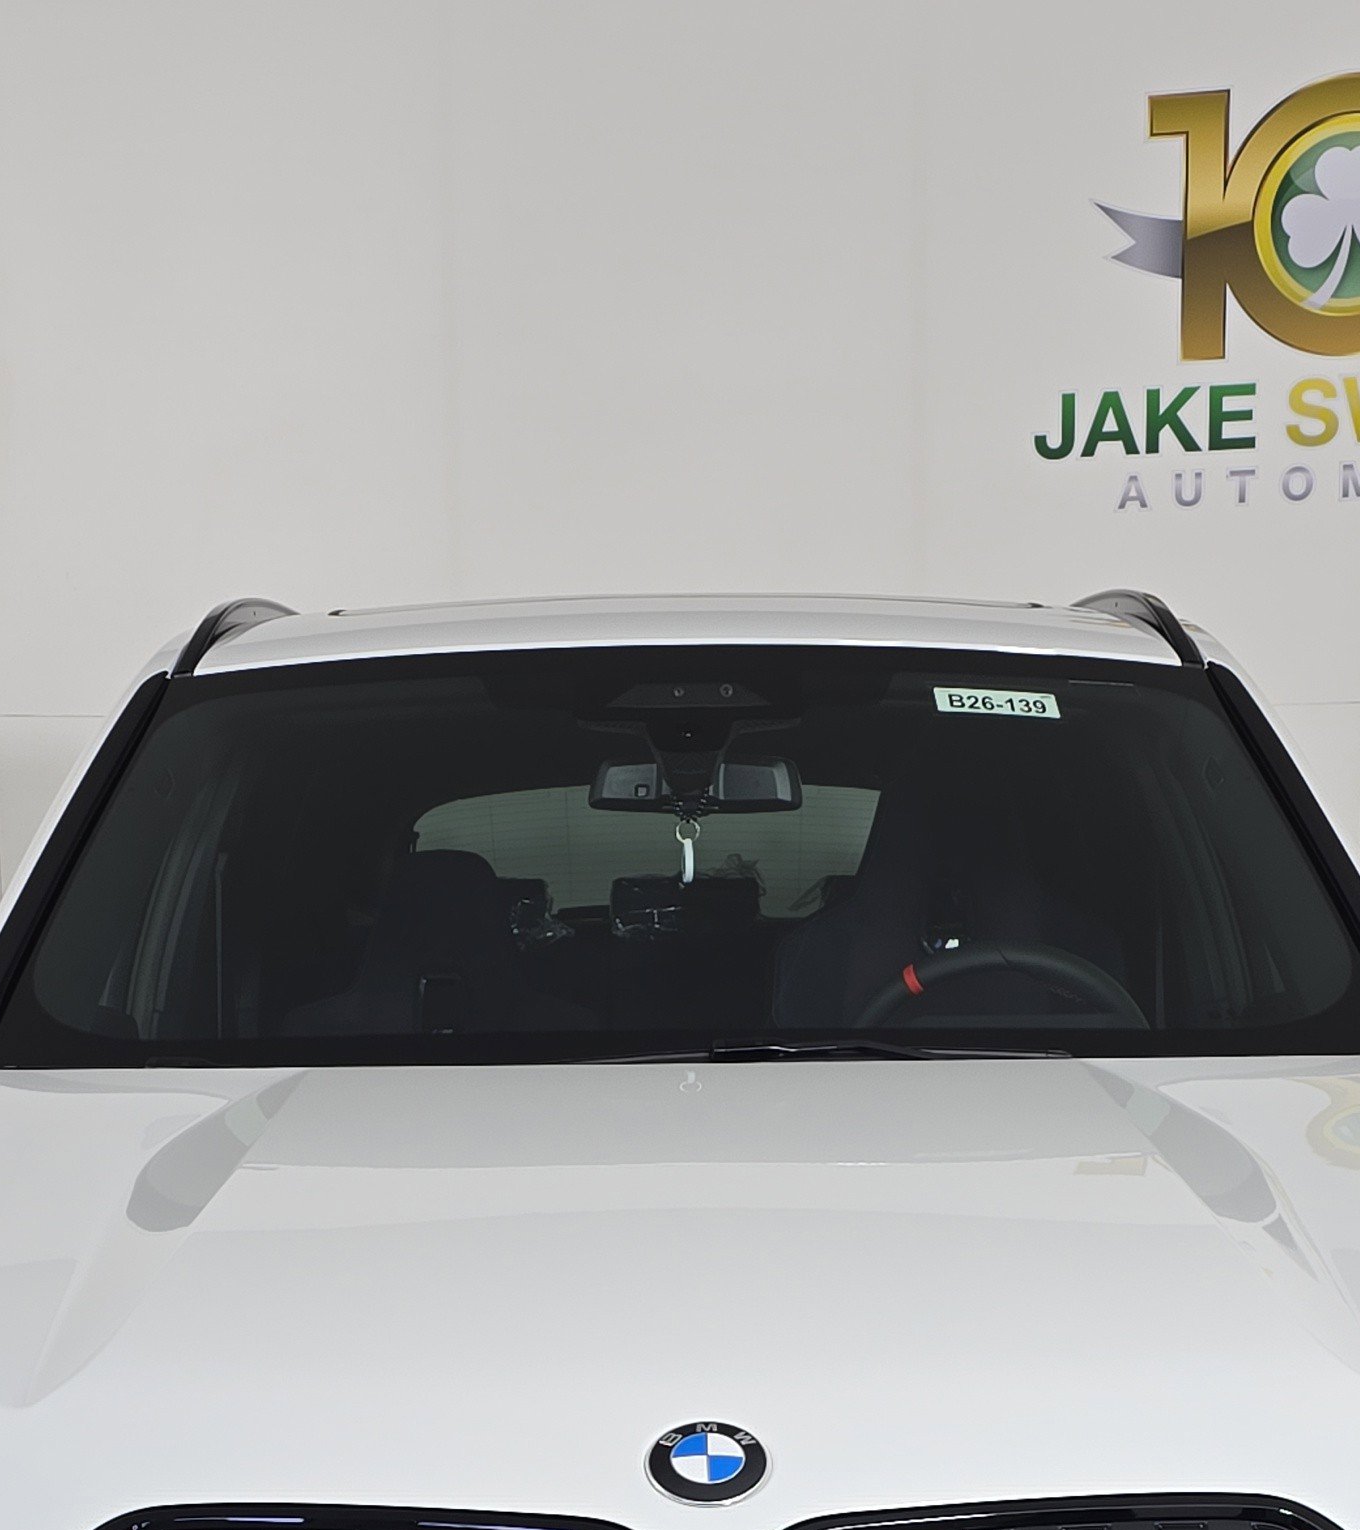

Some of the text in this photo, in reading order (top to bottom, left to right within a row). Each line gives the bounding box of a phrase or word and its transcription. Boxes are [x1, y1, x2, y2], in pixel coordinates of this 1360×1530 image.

[1034, 383, 1257, 460] JAKE
[947, 693, 1048, 714] B26-139
[659, 1423, 757, 1446] BMW
